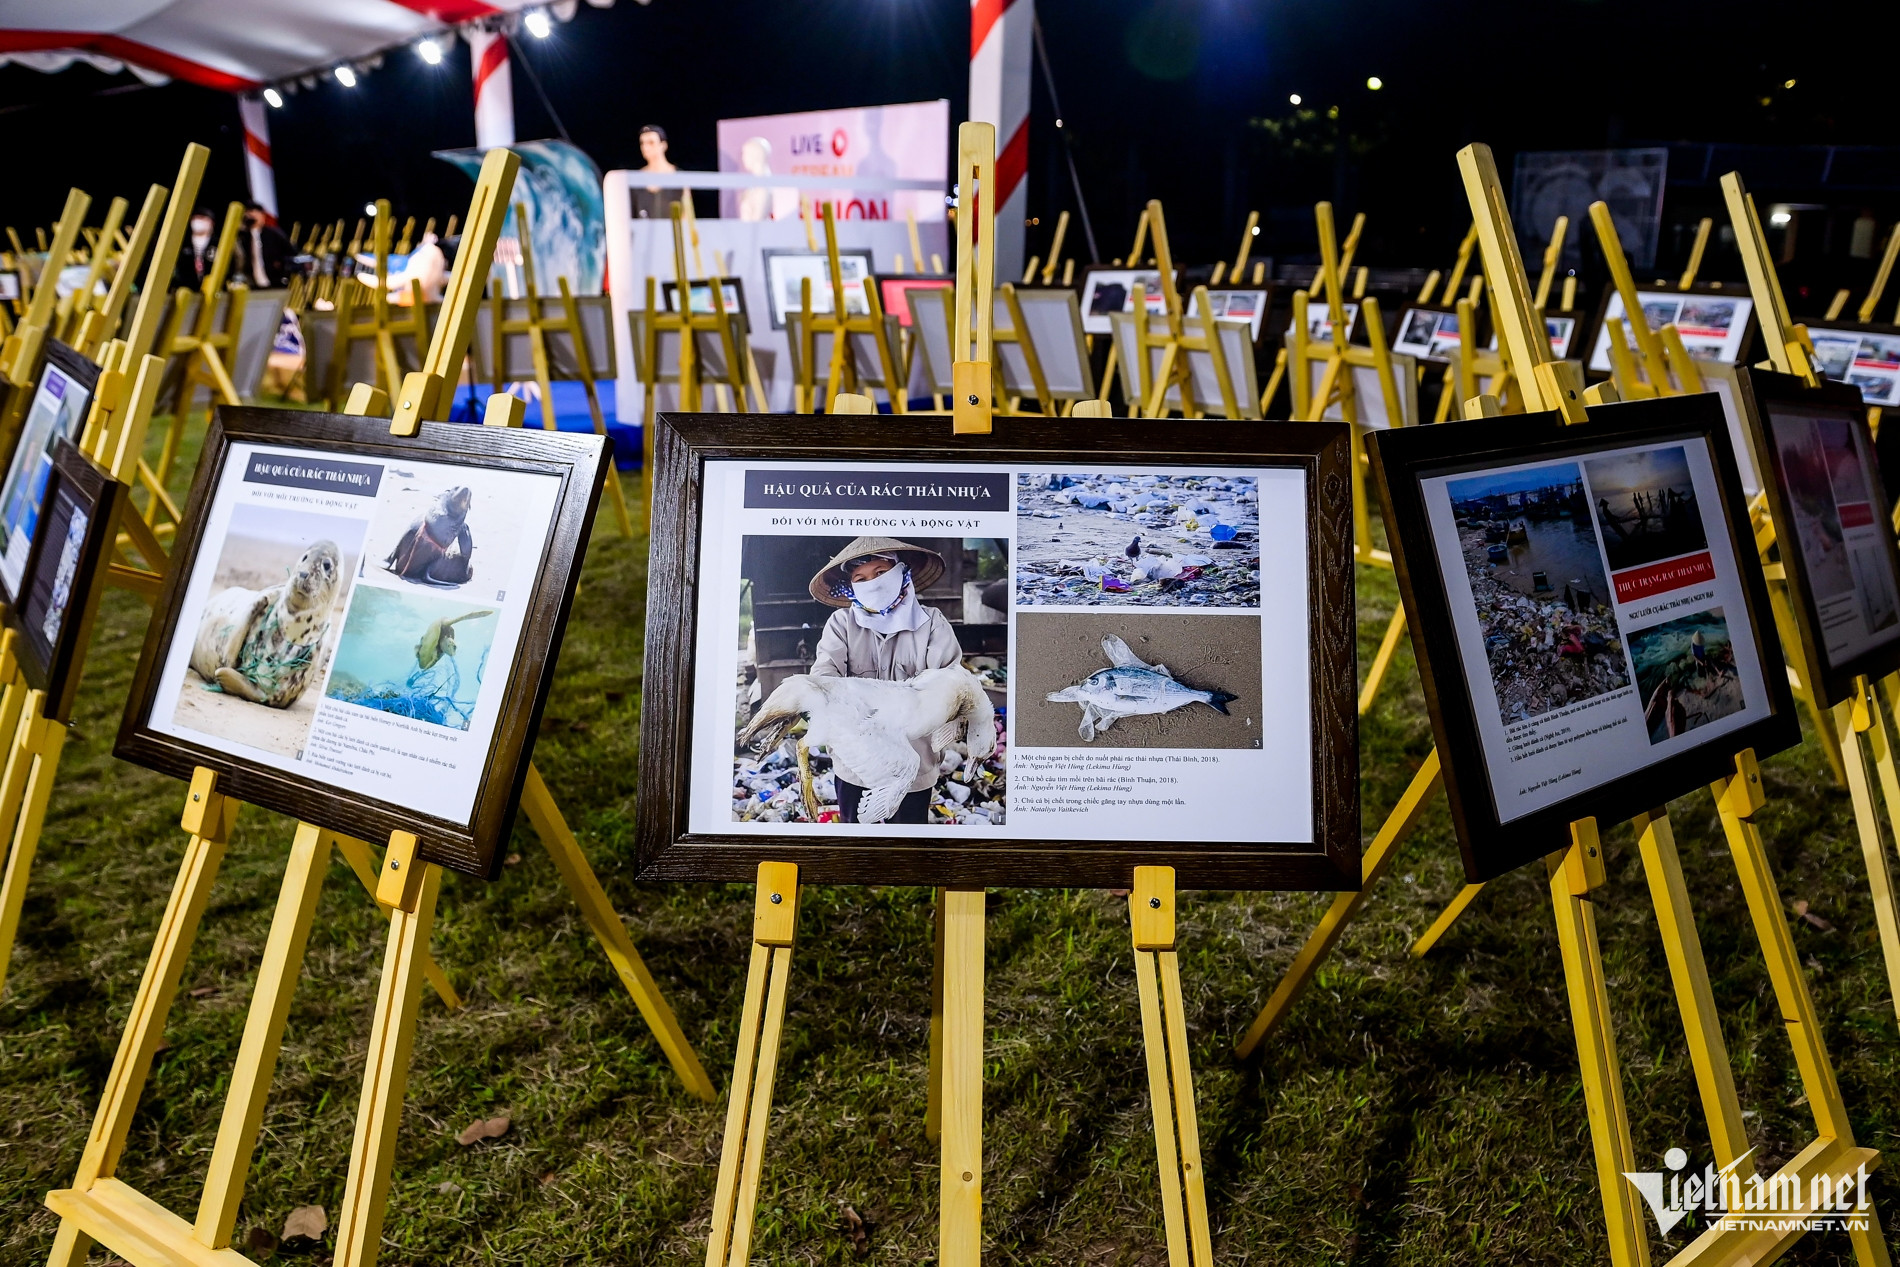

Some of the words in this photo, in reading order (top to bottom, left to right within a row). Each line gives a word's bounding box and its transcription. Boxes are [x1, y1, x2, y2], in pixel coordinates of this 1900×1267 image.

[790, 134, 822, 155] LIVE
[254, 463, 271, 475] HẬU
[272, 464, 288, 476] QUẢ
[289, 466, 305, 477] CỦA
[307, 467, 324, 479] RÁC
[326, 470, 346, 482] THẢI
[346, 473, 370, 486] NHỰA
[764, 483, 795, 497] HẬU
[800, 482, 832, 497] QUẢ
[836, 483, 867, 495] CỦA
[871, 483, 902, 496] RÁC
[906, 484, 942, 496] THẢI
[948, 486, 990, 499] NHỰA
[1254, 739, 1260, 747] 3
